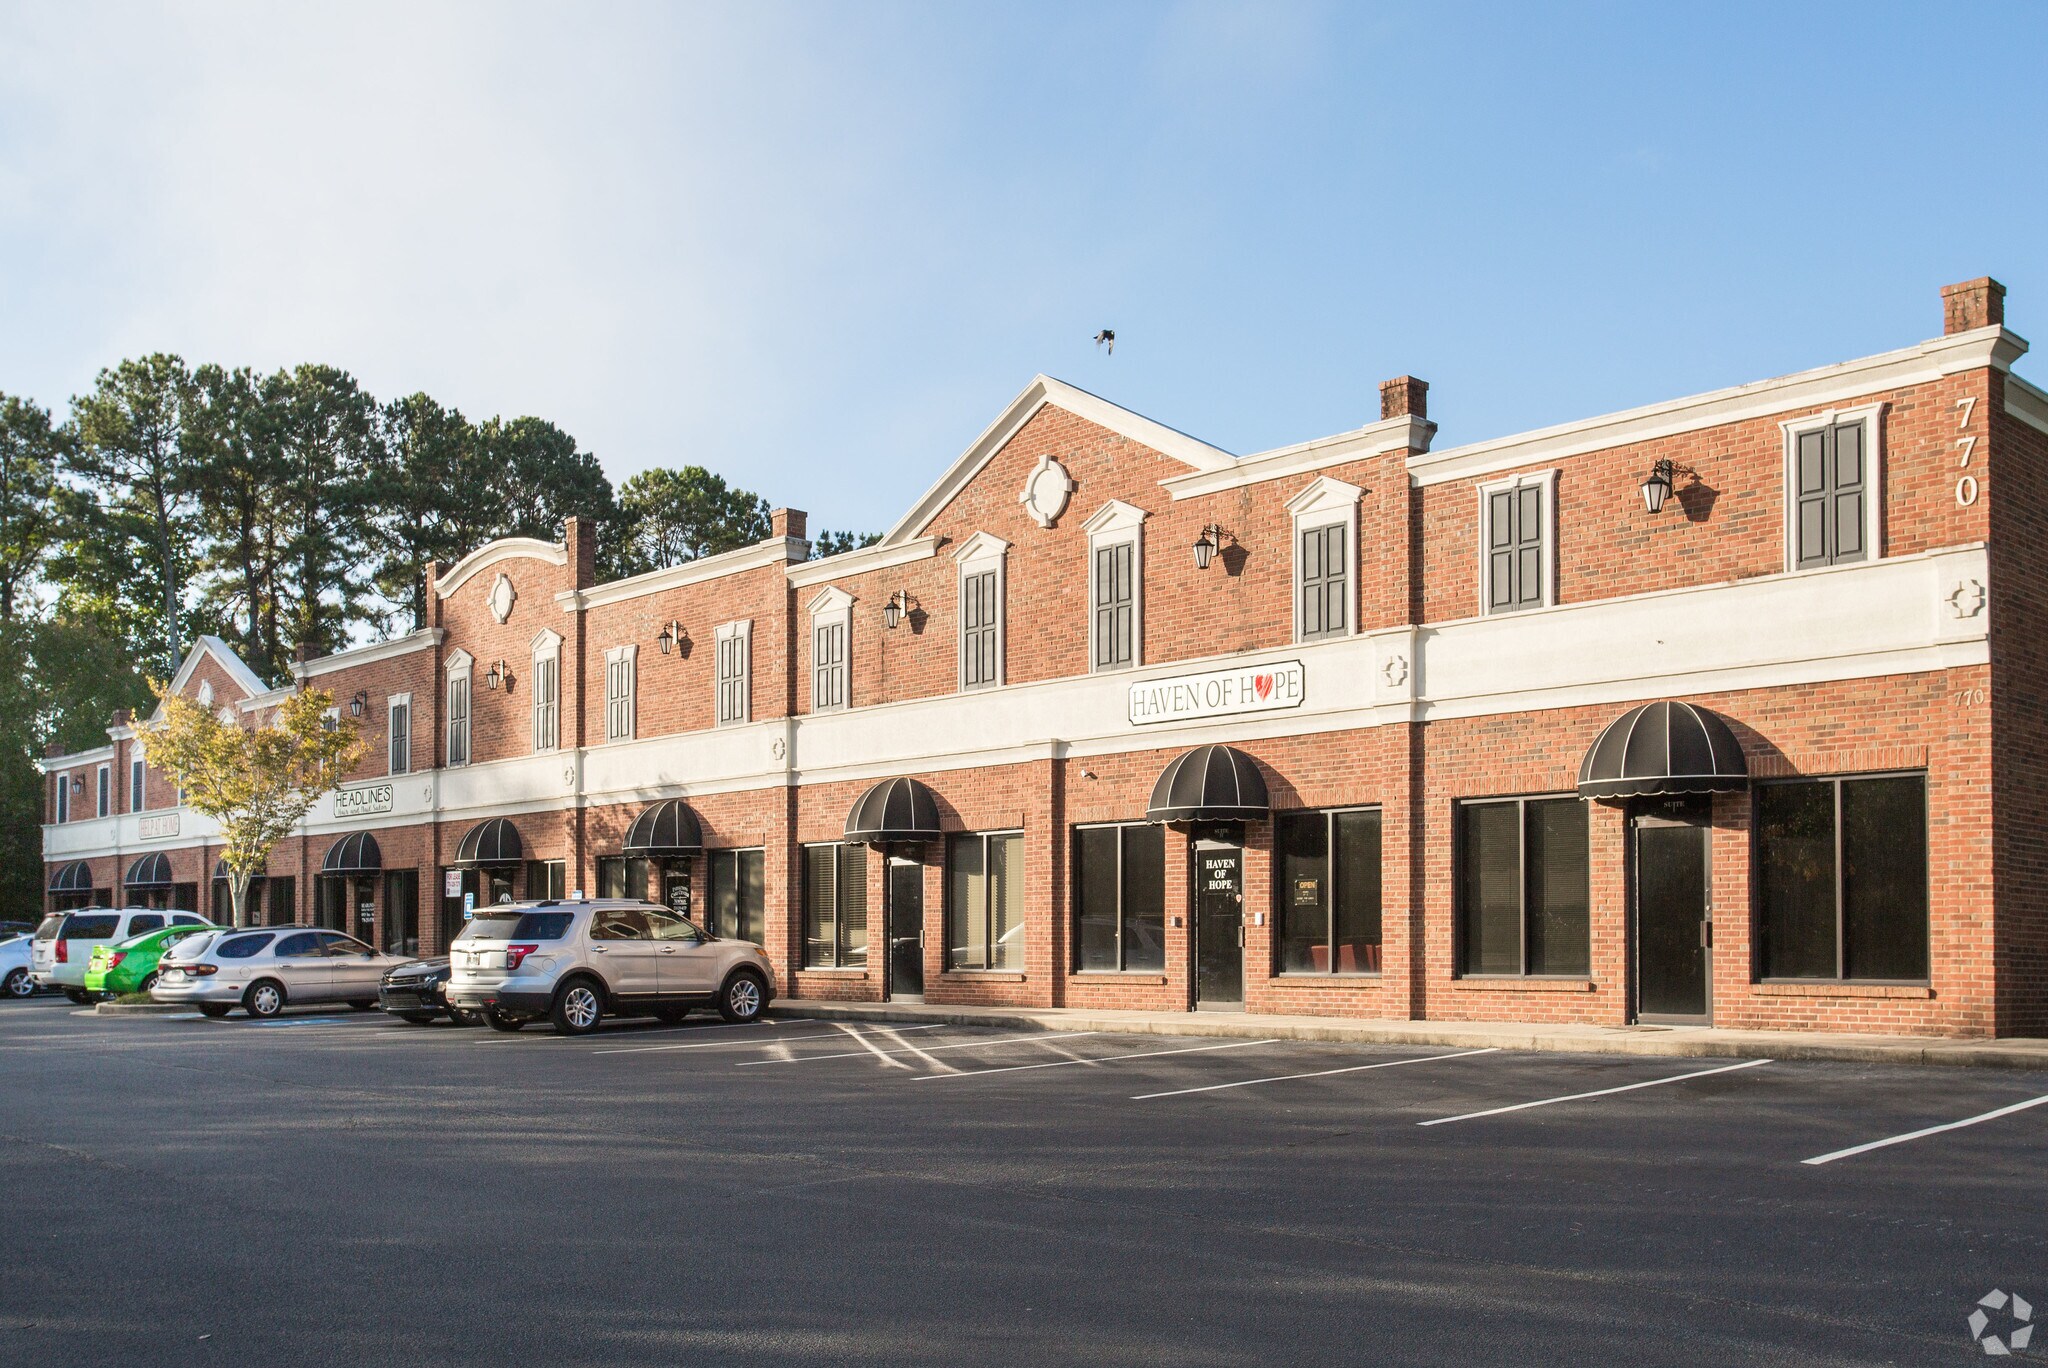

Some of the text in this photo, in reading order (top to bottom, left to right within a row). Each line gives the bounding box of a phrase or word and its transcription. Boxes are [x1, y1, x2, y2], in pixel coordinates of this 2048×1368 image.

[1956, 396, 1978, 506] 770
[1133, 682, 1200, 716] HAVEN
[1206, 678, 1233, 707] OF
[1954, 689, 1984, 706] 770
[336, 787, 391, 808] HEADLINES
[1206, 859, 1235, 869] HAVEN
[1214, 870, 1227, 879] OF
[1209, 880, 1233, 890] HOPE
[1299, 881, 1315, 889] OPEN
